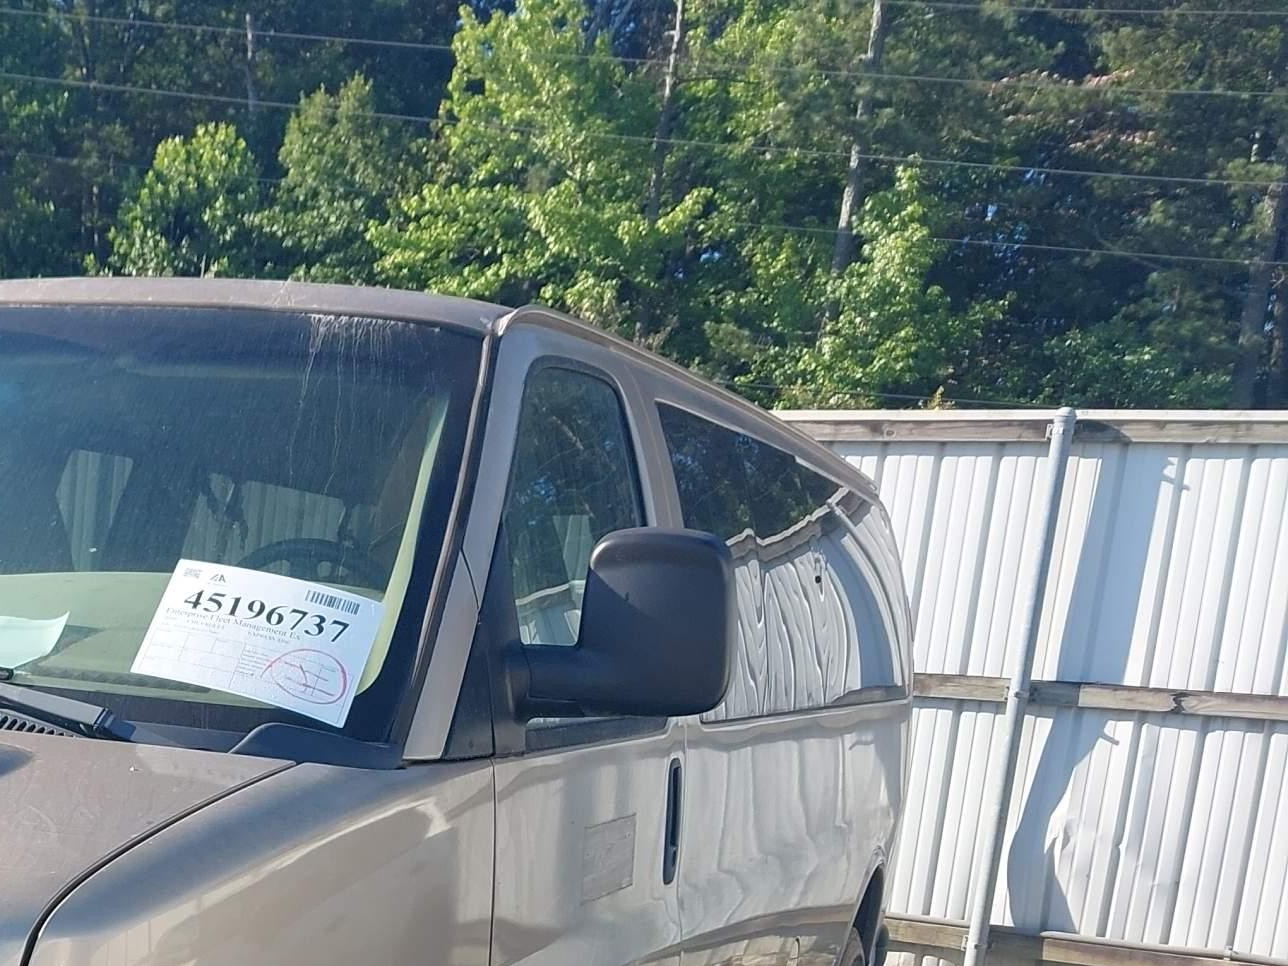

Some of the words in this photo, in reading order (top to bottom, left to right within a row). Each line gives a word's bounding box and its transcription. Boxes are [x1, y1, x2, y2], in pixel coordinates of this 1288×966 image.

[184, 590, 350, 642] 45196737
[210, 613, 231, 624] Fleet
[233, 618, 287, 637] Management
